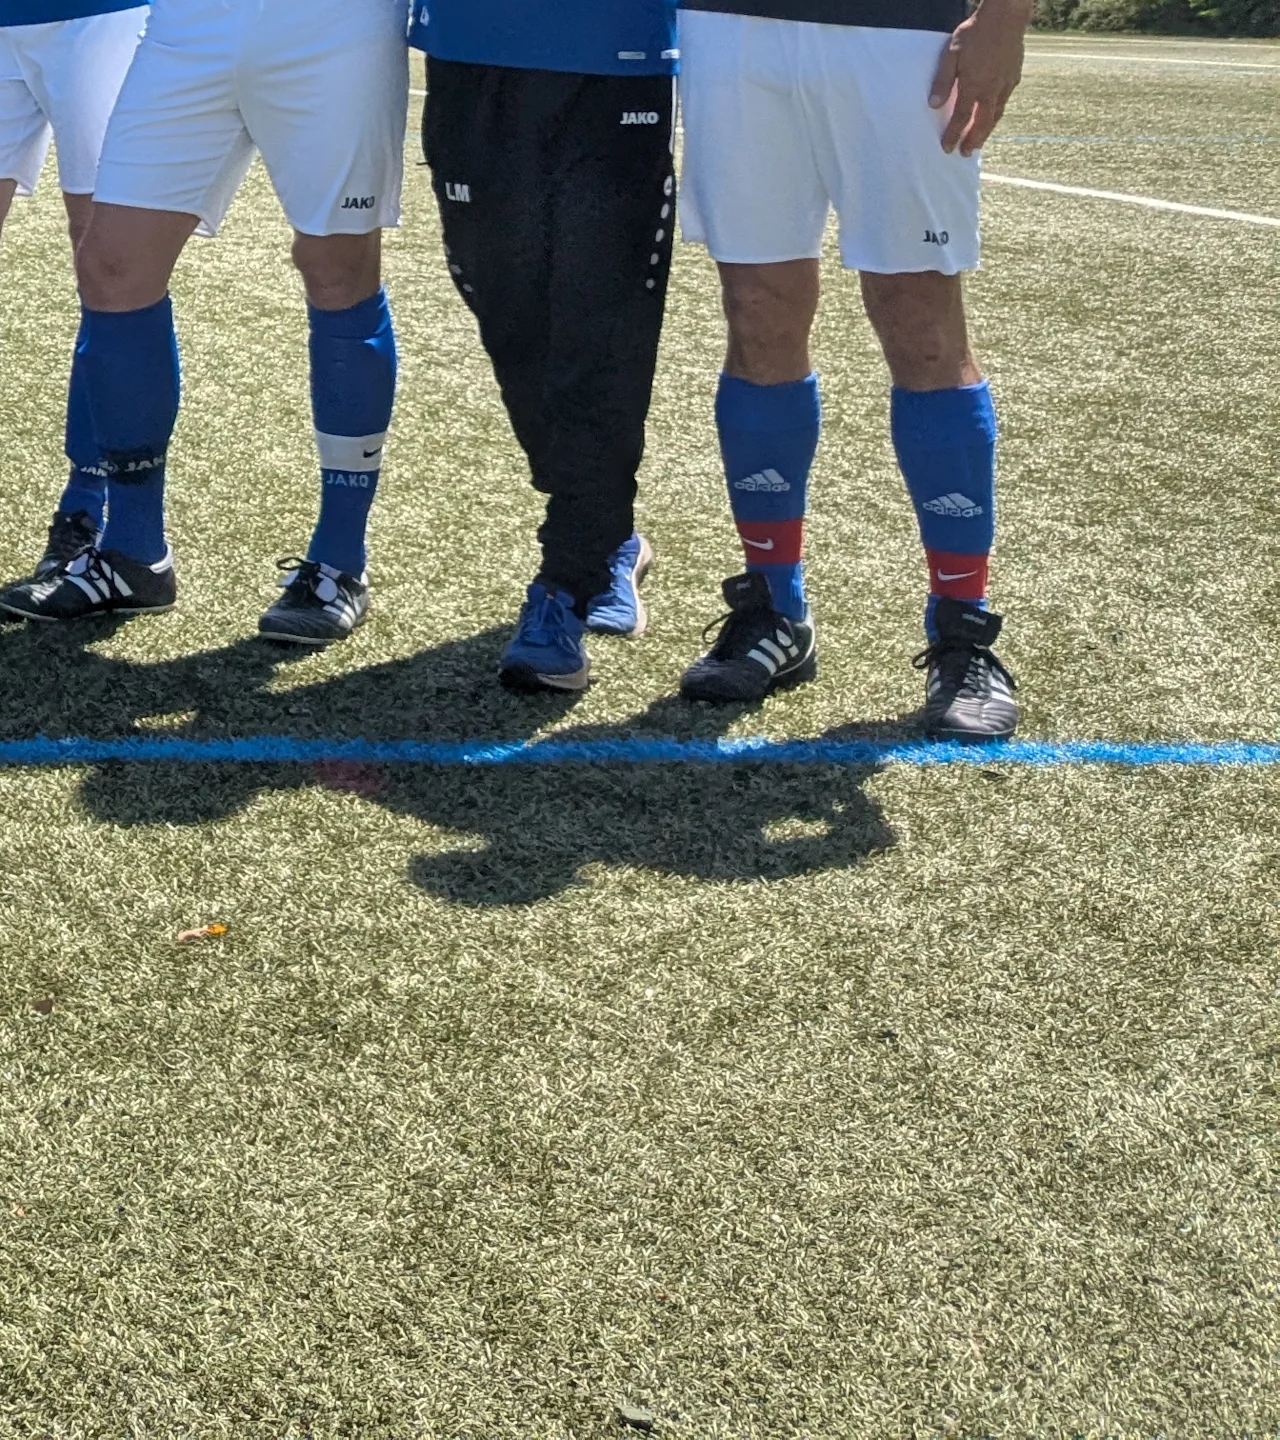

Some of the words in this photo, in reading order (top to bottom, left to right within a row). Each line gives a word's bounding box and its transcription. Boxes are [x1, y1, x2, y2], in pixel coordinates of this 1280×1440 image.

[620, 112, 659, 125] JAKO
[445, 181, 471, 203] LM
[342, 195, 375, 208] JAKO
[326, 473, 369, 488] JAKO
[734, 480, 791, 493] adidas
[922, 500, 984, 518] adidas
